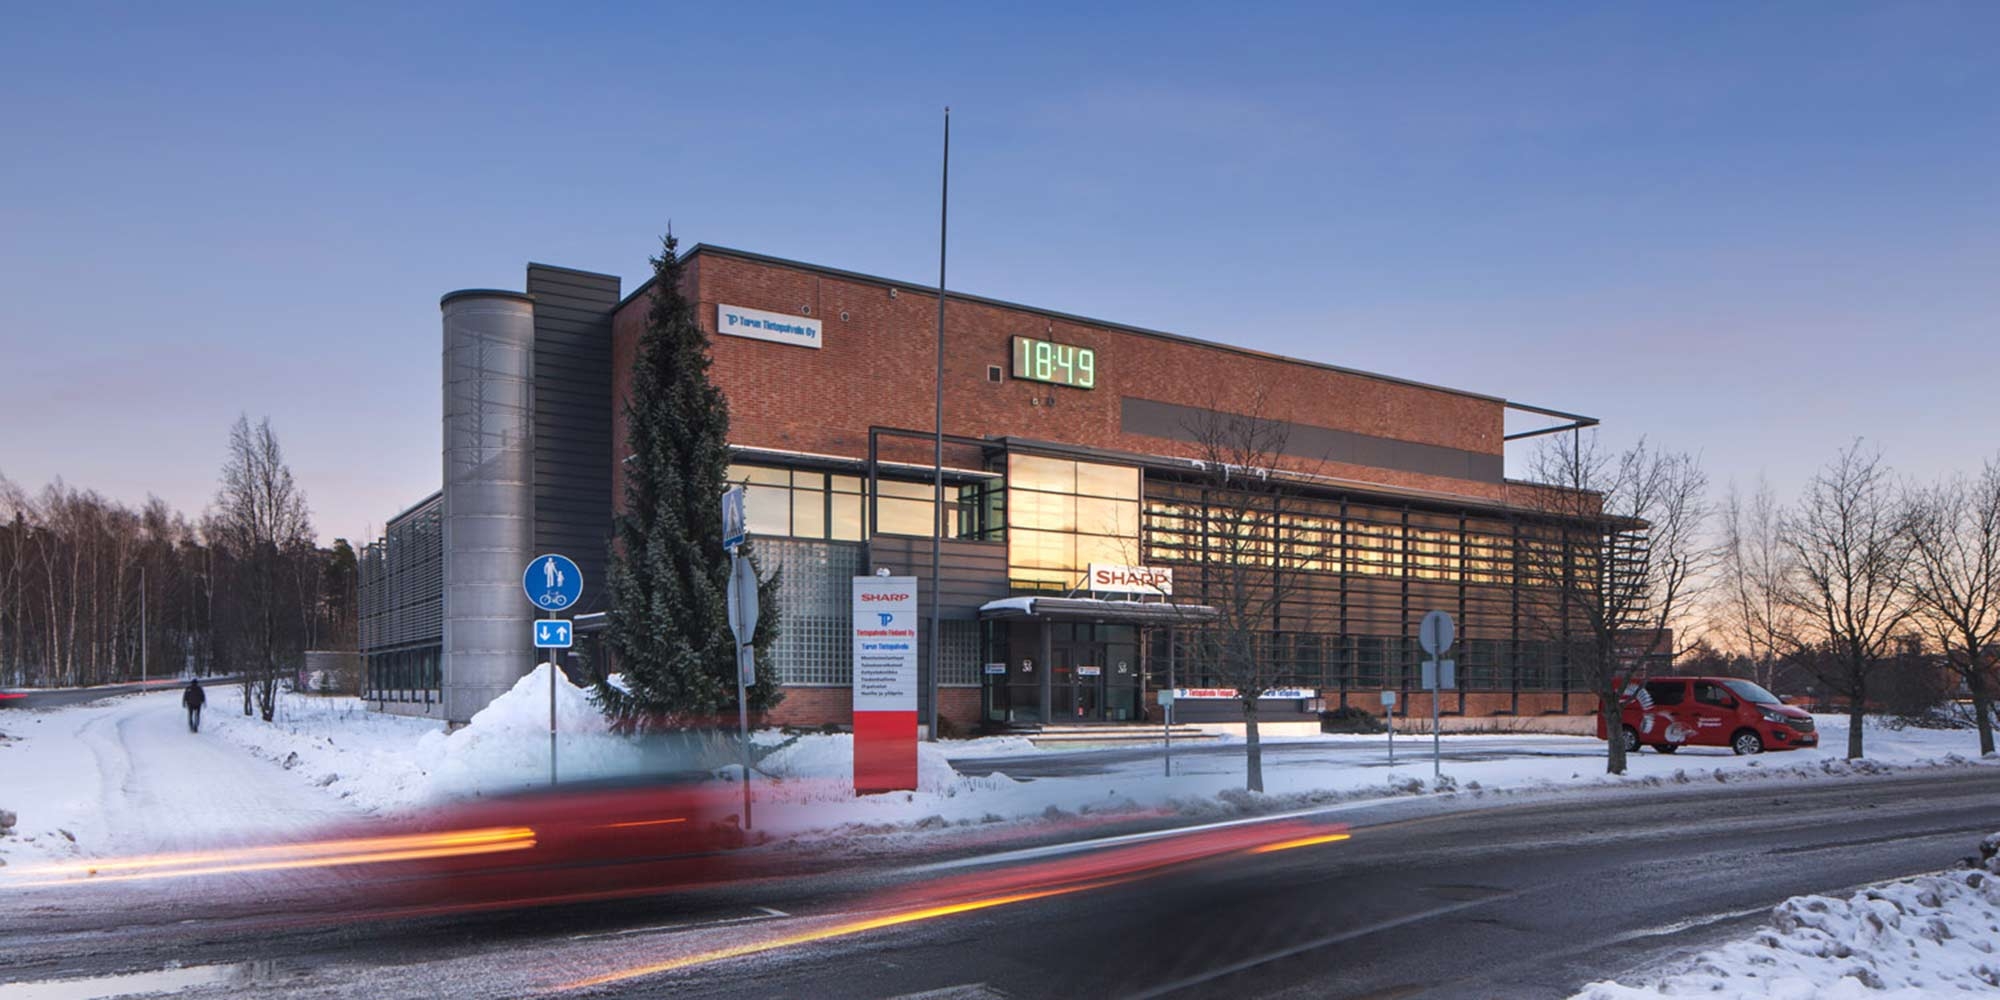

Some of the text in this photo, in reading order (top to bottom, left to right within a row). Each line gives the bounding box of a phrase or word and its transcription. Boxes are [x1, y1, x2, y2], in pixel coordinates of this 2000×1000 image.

[1022, 339, 1094, 387] 18:49
[1096, 570, 1168, 587] SHARP
[861, 593, 909, 601] SHARP
